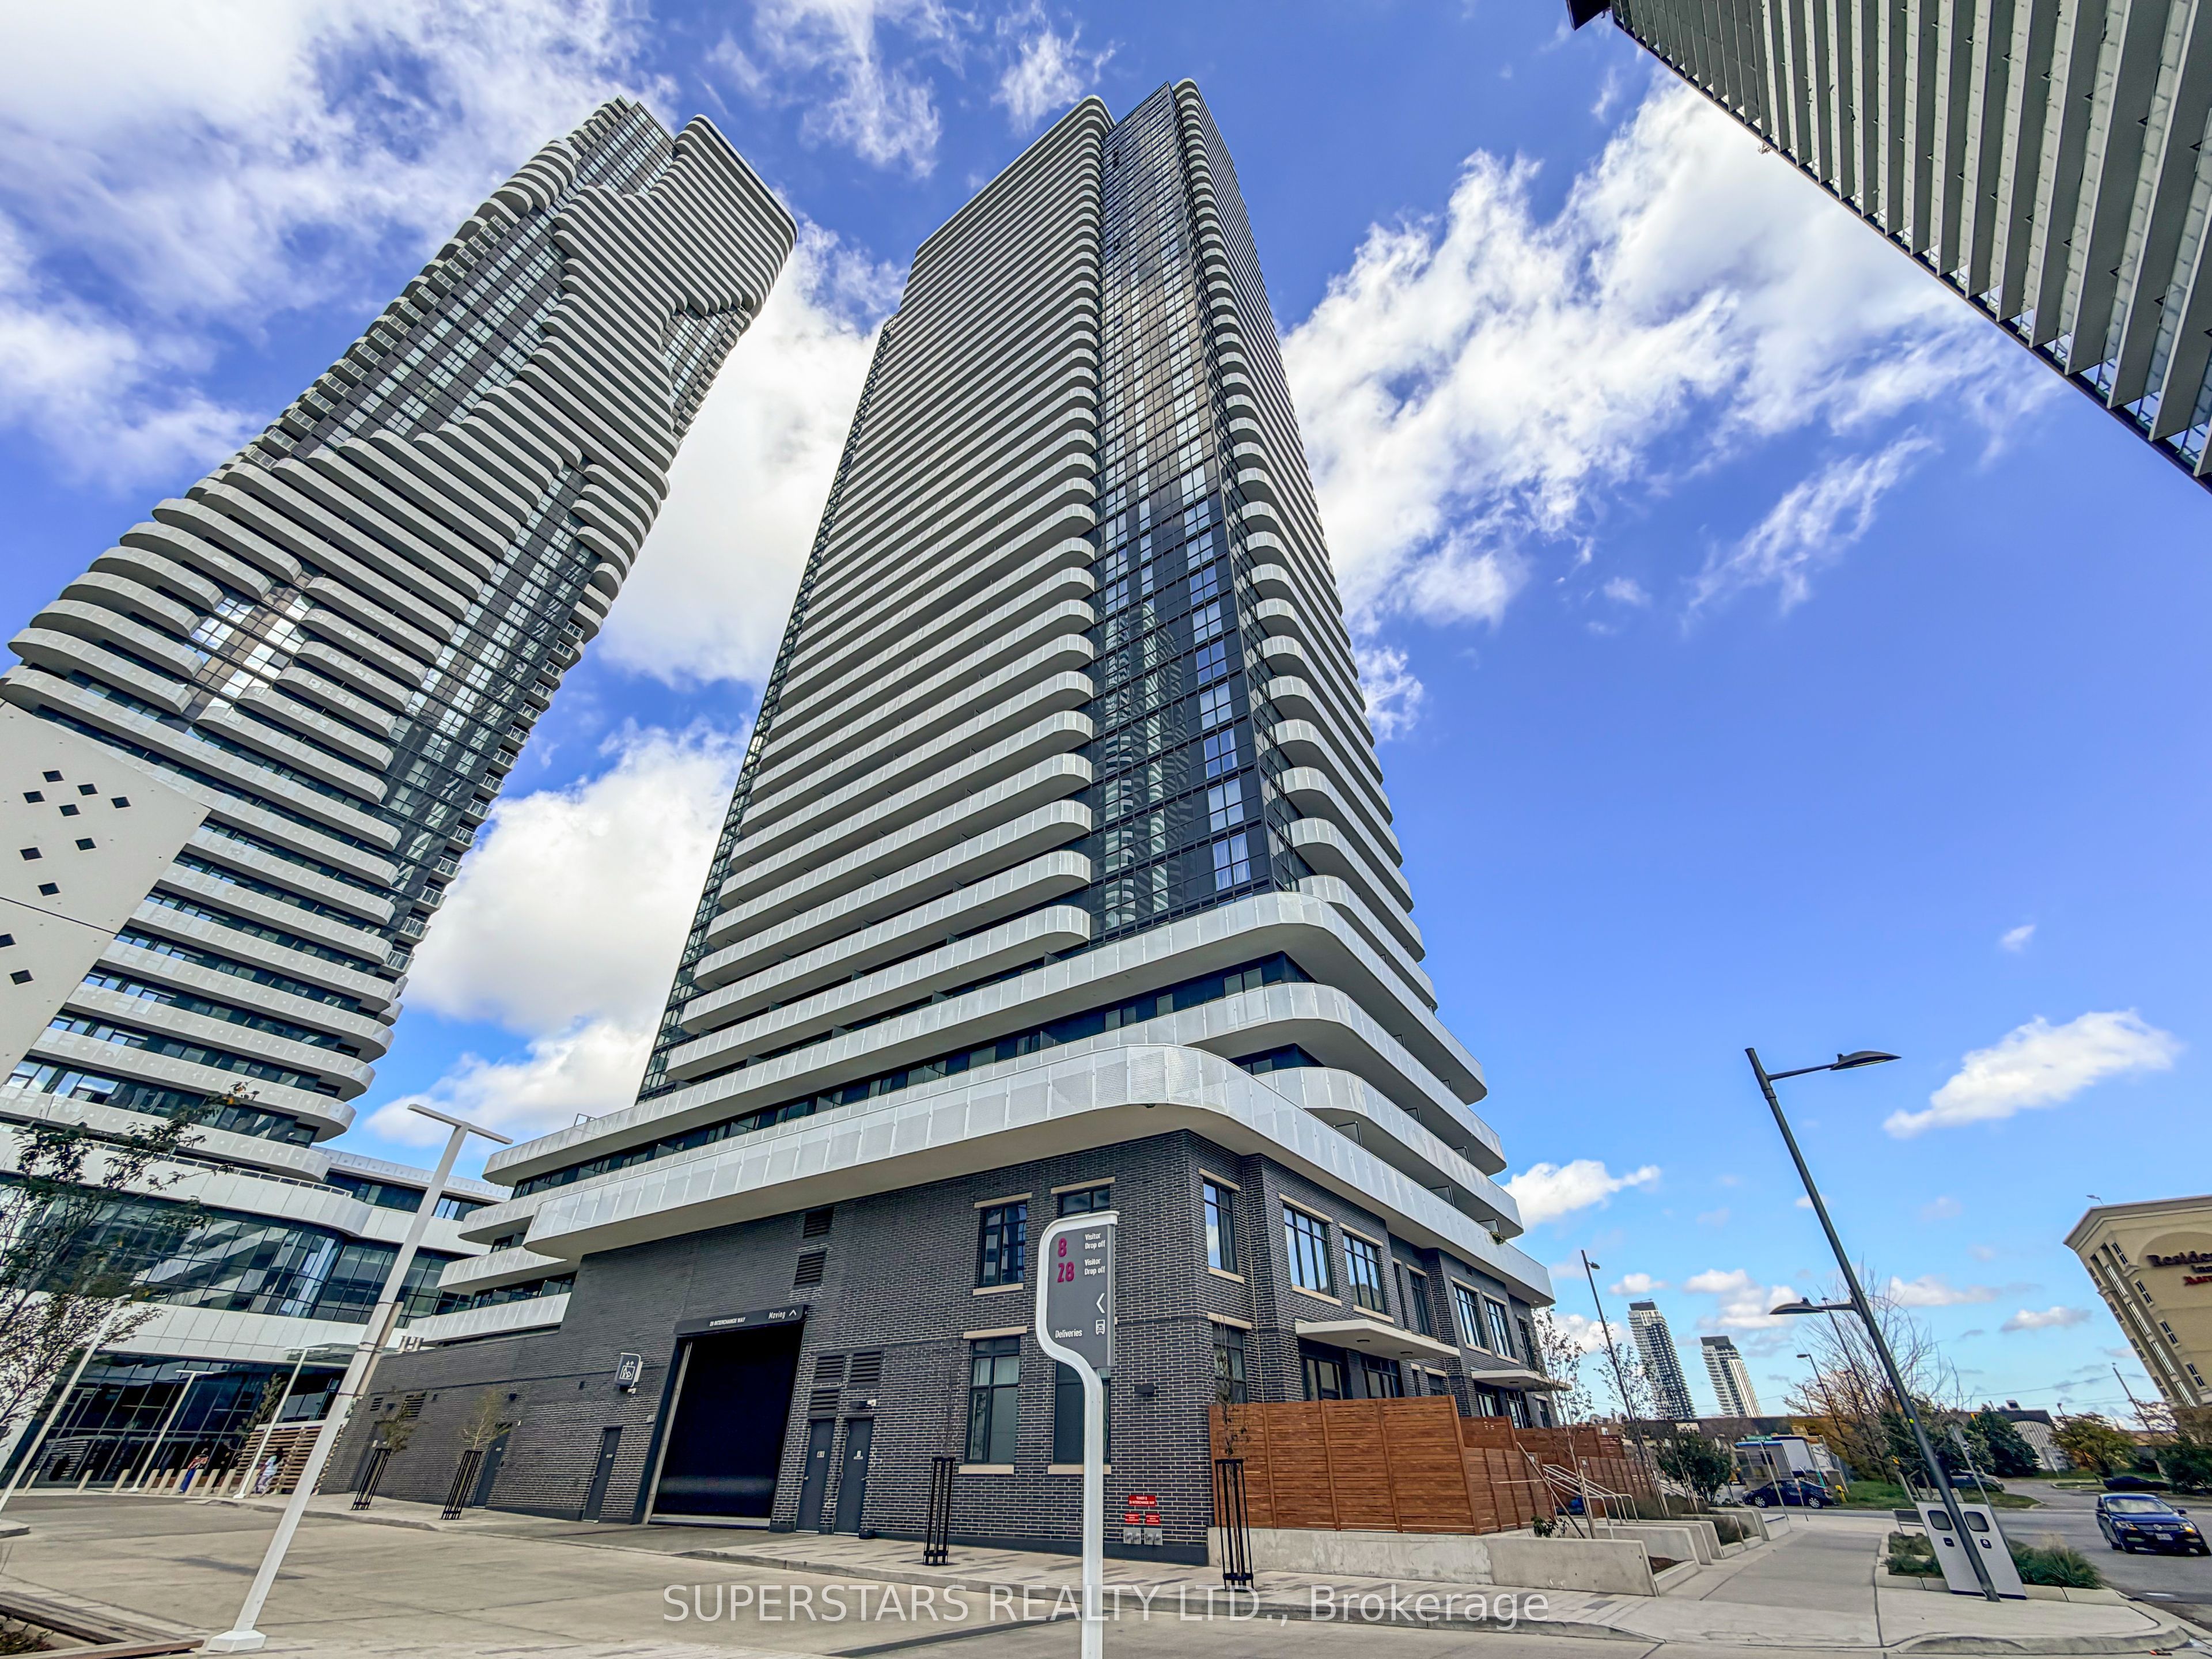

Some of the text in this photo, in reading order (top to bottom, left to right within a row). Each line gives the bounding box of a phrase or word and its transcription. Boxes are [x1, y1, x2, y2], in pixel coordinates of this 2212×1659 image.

[1058, 1238, 1067, 1257] 8
[1085, 1258, 1101, 1266] Visitor
[1057, 1262, 1075, 1282] 28
[1084, 1268, 1096, 1276] Drop
[768, 1310, 786, 1319] Moving
[1055, 1328, 1082, 1338] Deliveries
